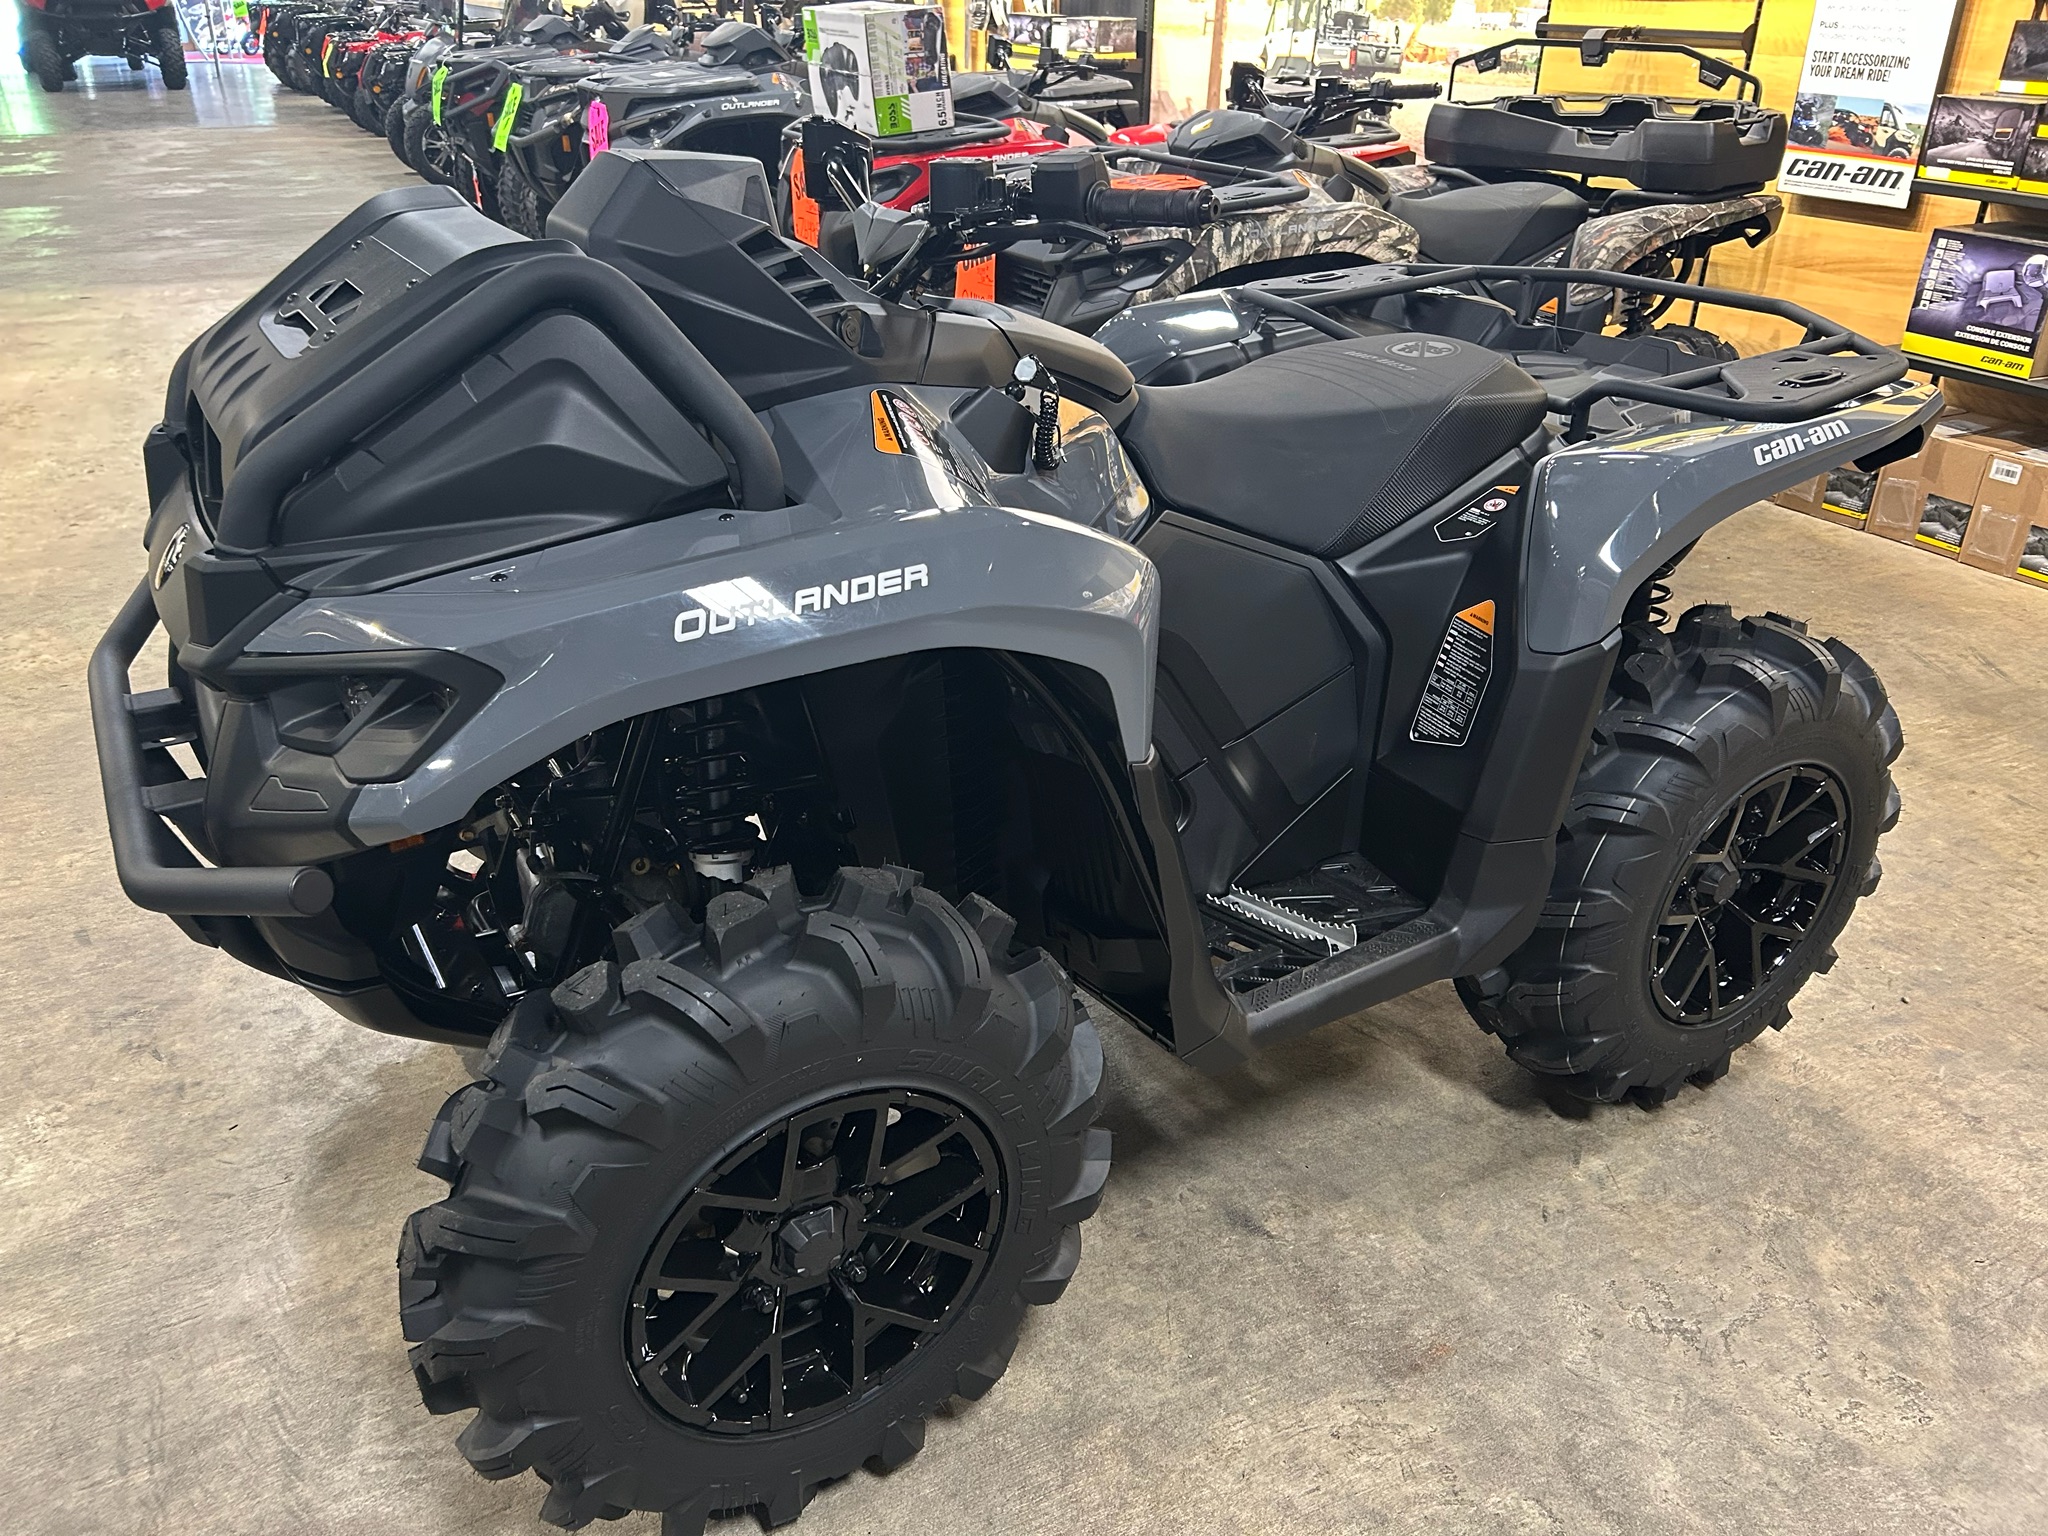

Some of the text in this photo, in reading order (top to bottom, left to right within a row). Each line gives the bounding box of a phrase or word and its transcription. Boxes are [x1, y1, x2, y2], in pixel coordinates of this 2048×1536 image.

[1819, 20, 1839, 29] PLUS
[940, 53, 949, 87] TAILGATING
[1809, 64, 1891, 83] YOUR DREAM RIDE!
[1811, 50, 1911, 69] START ACCESSORIZING
[721, 100, 780, 111] OUTLANDER
[888, 102, 898, 129] BOSS
[935, 91, 948, 127] 6.5 INCH
[591, 119, 606, 152] SALE
[1786, 158, 1905, 190] can-am
[1954, 330, 2030, 352] EXTENSION DE CONSOLE
[1966, 325, 2033, 344] CONSOLE EXTENSION
[1980, 355, 2025, 371] can-am
[1753, 419, 1851, 466] can-am
[673, 563, 929, 643] OUTLANDER
[896, 1048, 1028, 1128] SWAMP
[1013, 1140, 1043, 1235] KING
